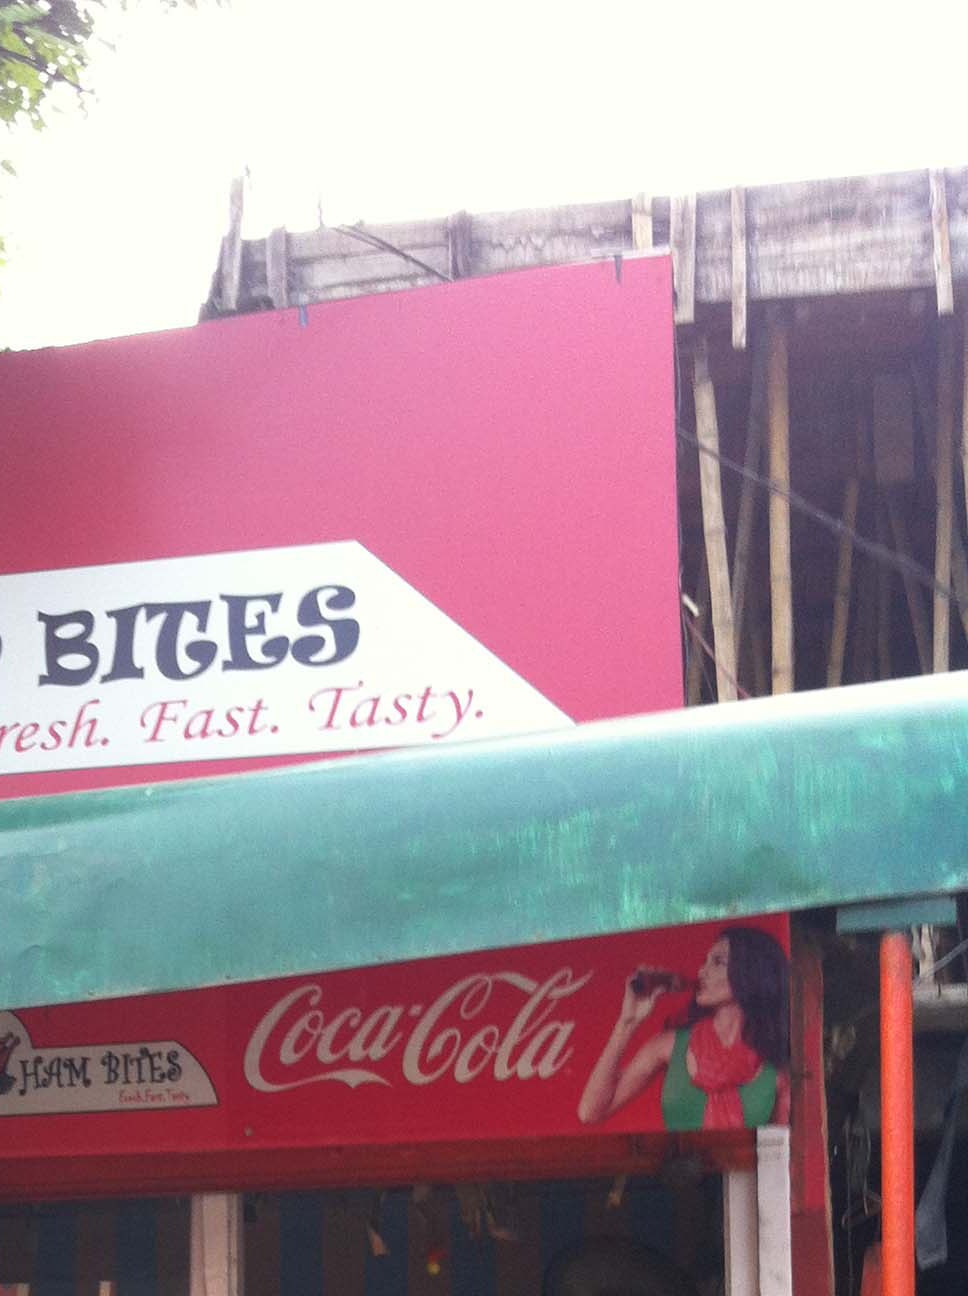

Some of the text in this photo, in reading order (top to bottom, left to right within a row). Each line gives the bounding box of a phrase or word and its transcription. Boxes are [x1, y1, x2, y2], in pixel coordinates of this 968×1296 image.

[37, 584, 361, 688] BITES
[140, 696, 279, 745] Fast.
[308, 682, 485, 740] Tasty.
[19, 1047, 183, 1096] HAM BITES
[243, 968, 595, 1093] Coca-Cola
